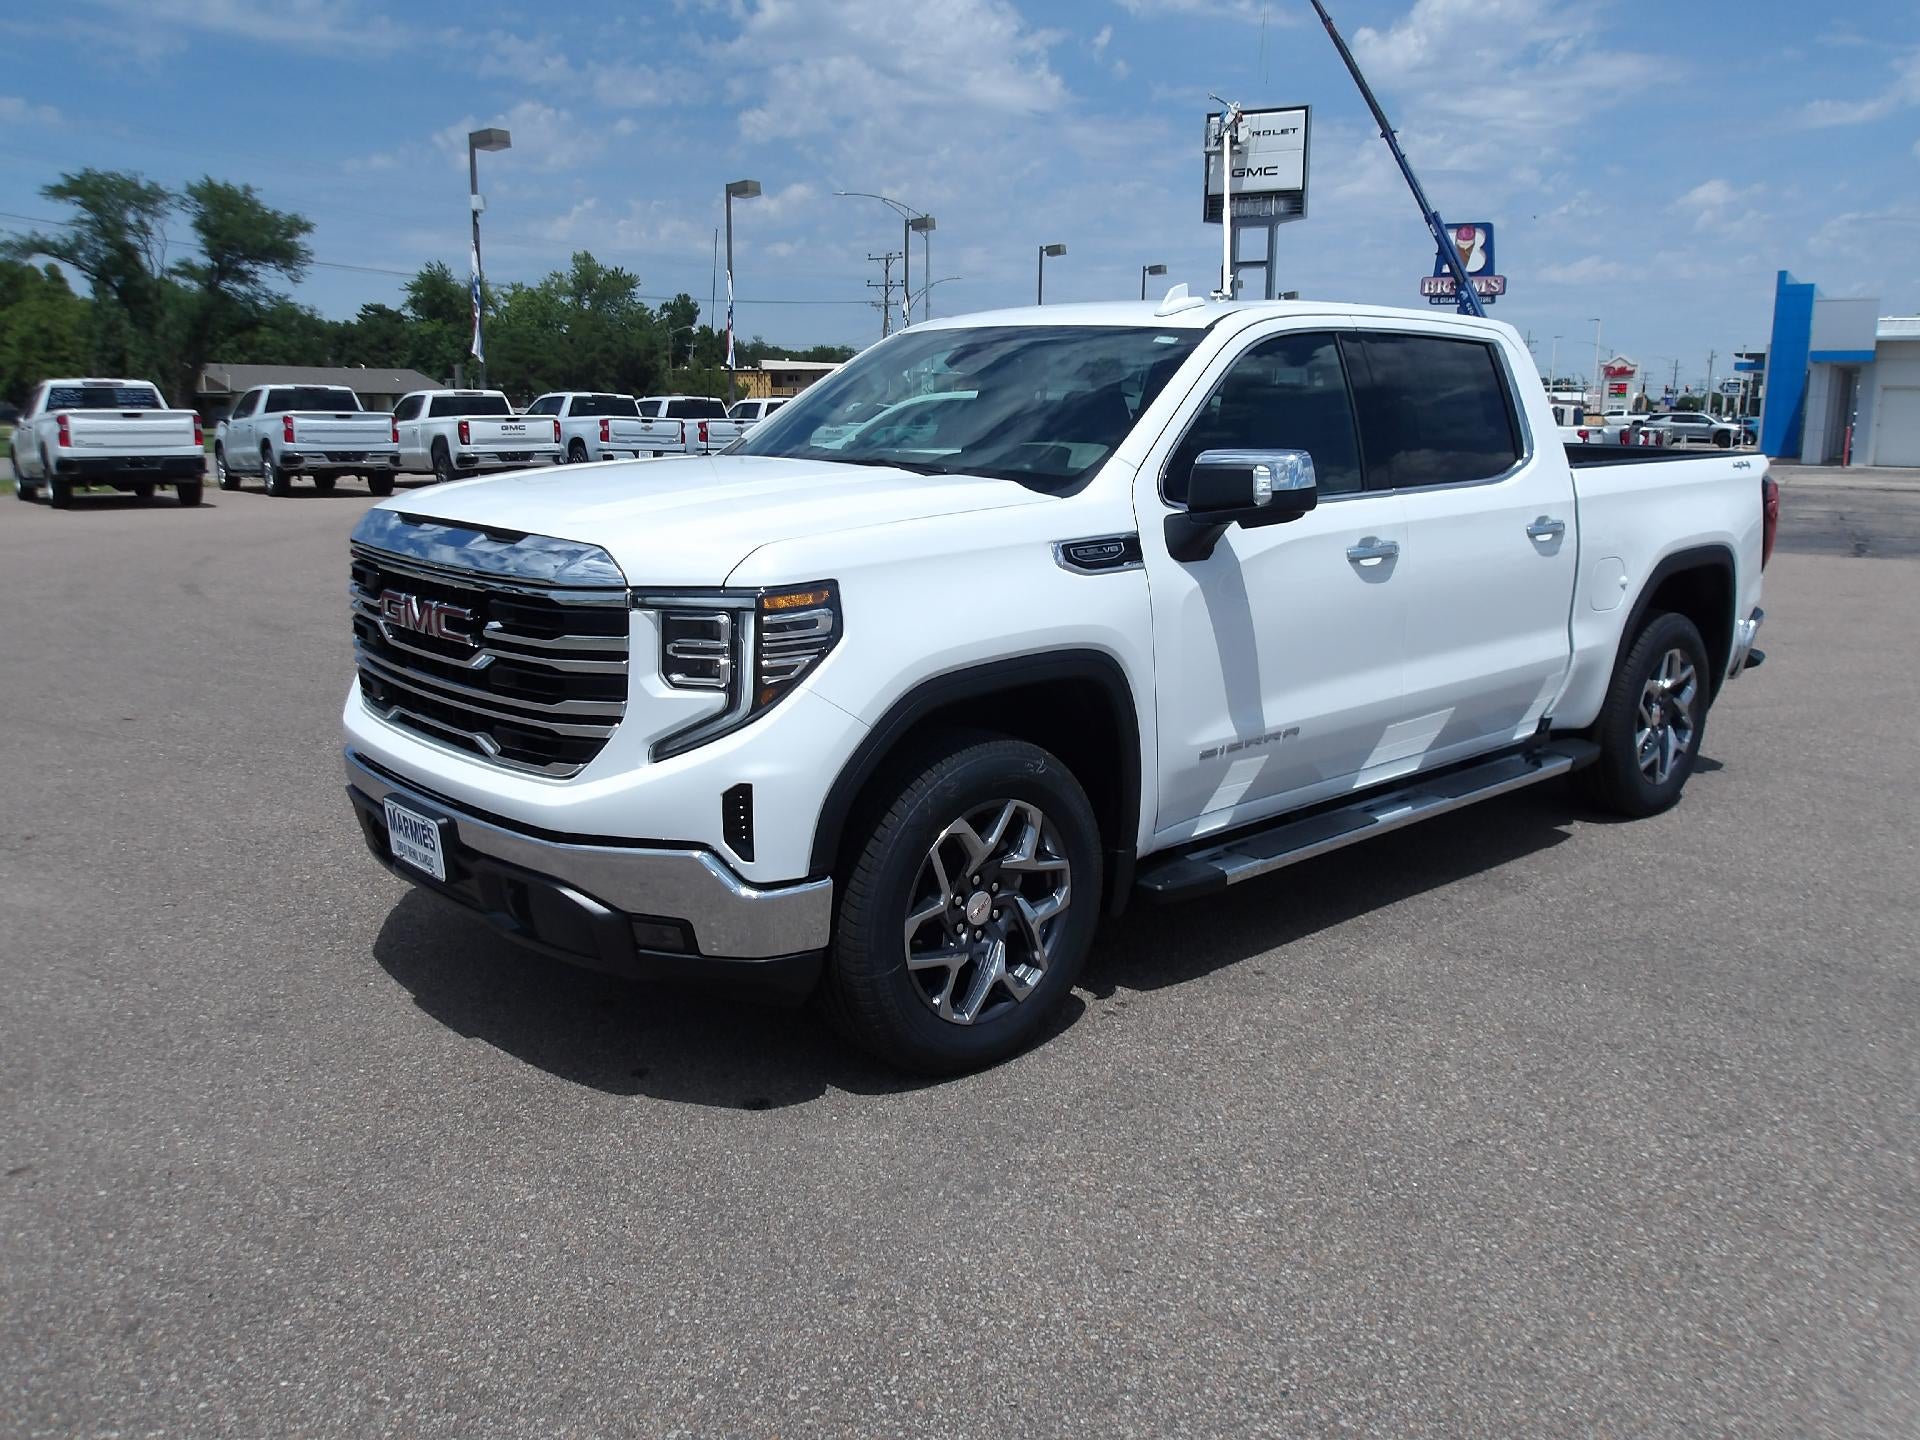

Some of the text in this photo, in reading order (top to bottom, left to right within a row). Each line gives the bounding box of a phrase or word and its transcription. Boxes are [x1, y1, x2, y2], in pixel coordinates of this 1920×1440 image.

[1250, 127, 1298, 138] ROLET
[1231, 166, 1278, 178] GMC
[1423, 279, 1501, 294] BRM'S
[379, 588, 474, 646] GMC
[387, 807, 436, 853] MARMIES
